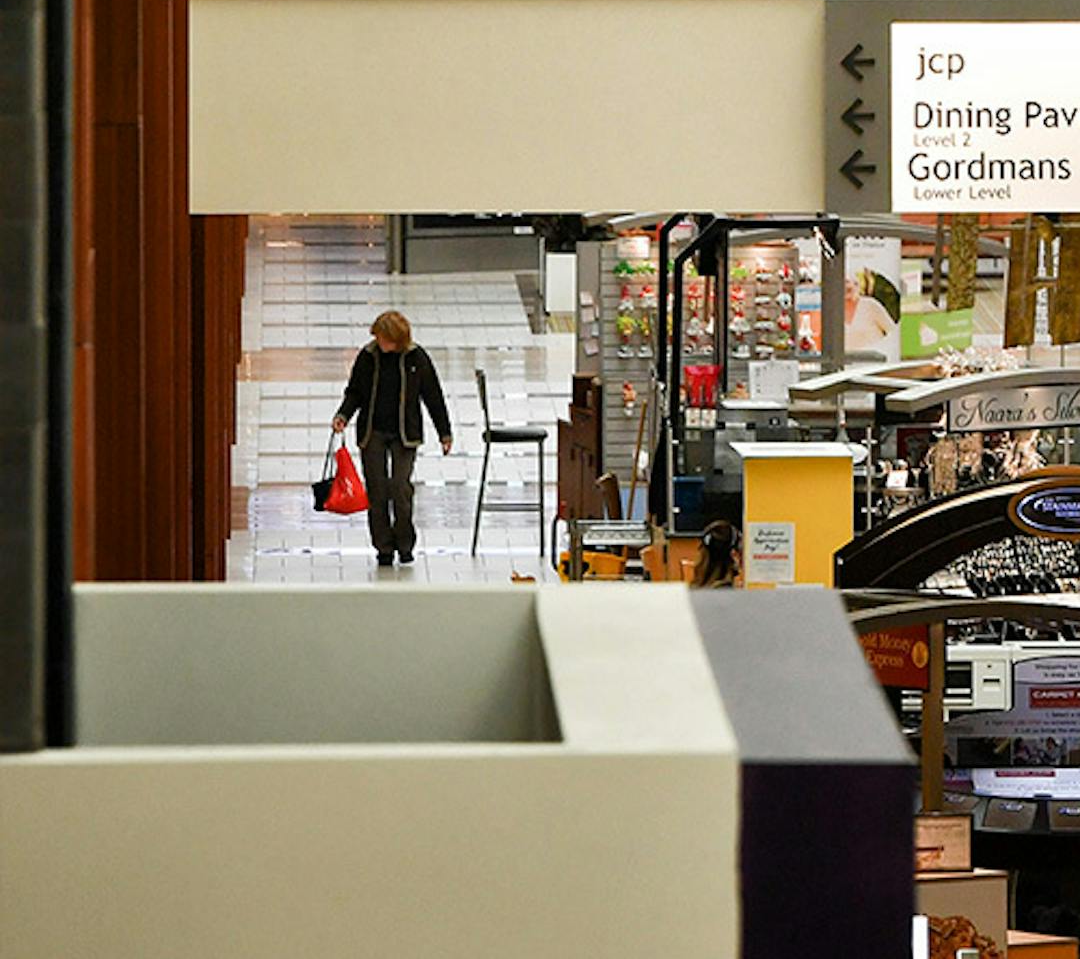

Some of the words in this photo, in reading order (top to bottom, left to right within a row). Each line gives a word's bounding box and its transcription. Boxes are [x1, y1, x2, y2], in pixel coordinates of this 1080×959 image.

[916, 46, 965, 80] jcp
[914, 101, 1011, 135] Dining
[913, 133, 956, 147] Level
[962, 132, 972, 147] 2
[908, 151, 1072, 181] Gordmans
[913, 186, 961, 200] Lower
[969, 185, 1012, 200] Level
